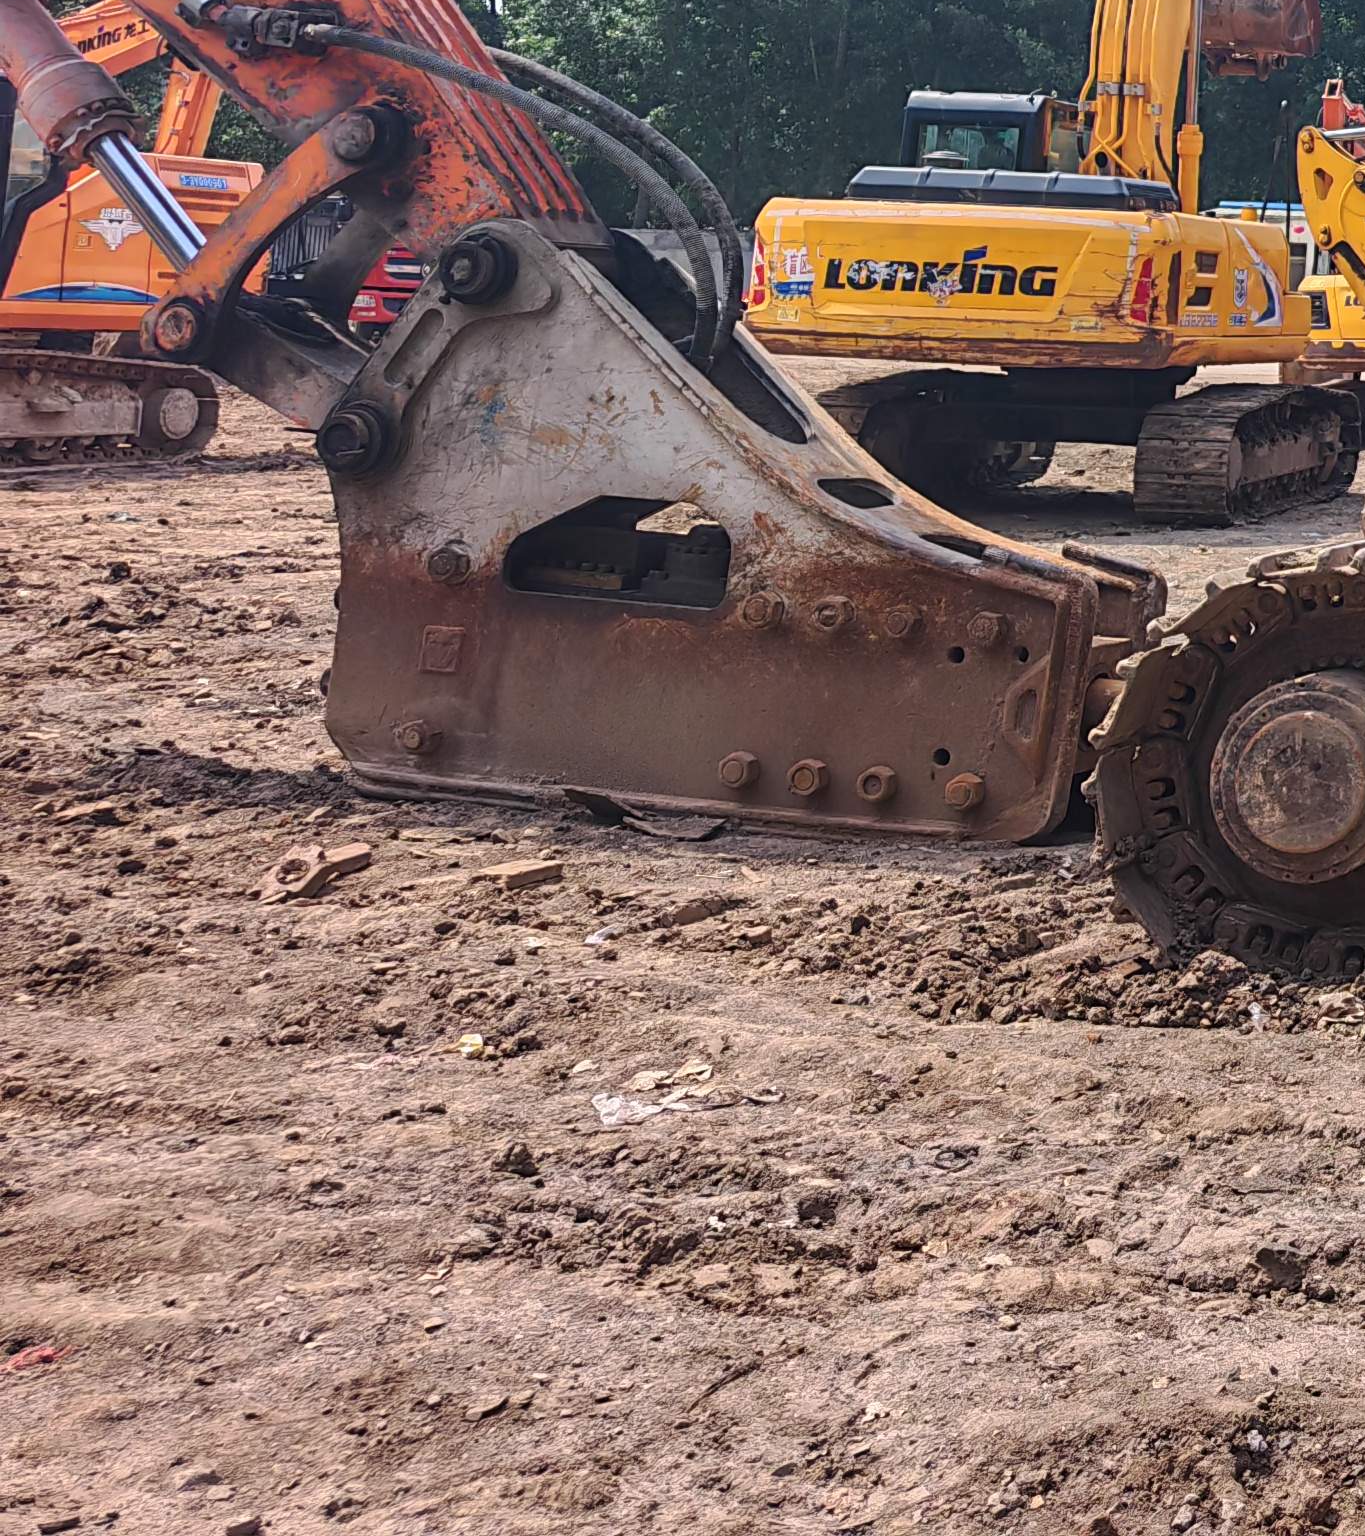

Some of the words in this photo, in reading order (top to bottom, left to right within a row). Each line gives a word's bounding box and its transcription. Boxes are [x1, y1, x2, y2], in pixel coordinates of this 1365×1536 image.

[77, 25, 122, 56] NKING
[123, 19, 150, 40] 龙工
[823, 245, 1059, 297] LONKING
